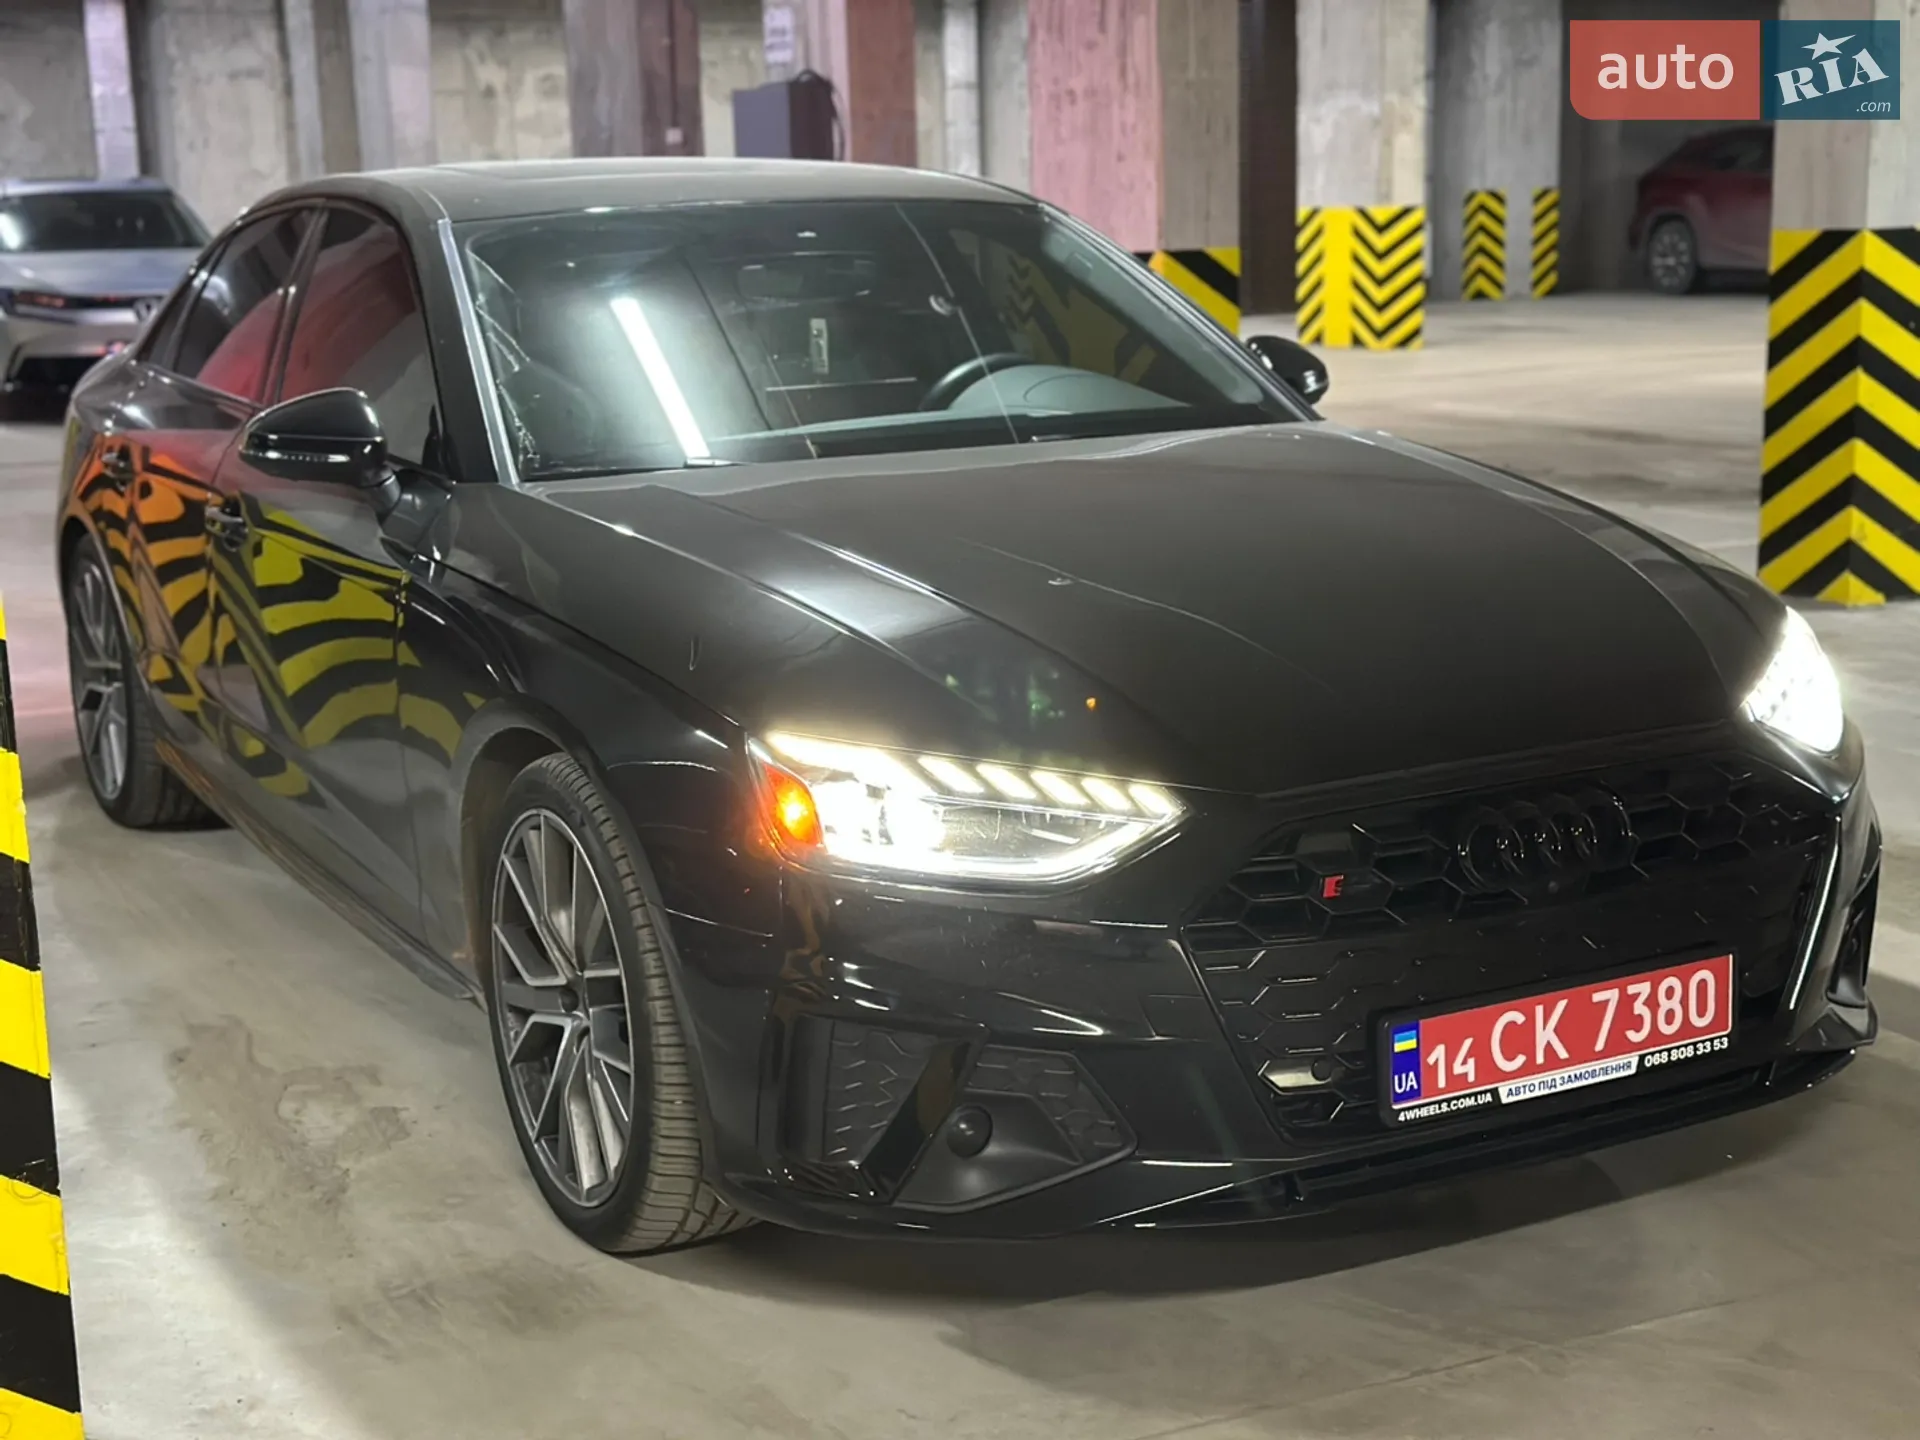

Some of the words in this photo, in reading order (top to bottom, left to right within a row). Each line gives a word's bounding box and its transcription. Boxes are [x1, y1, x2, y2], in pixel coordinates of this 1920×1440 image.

[1426, 1037, 1475, 1089] 14
[1490, 999, 1569, 1073] CK
[1591, 969, 1716, 1053] 7380
[1644, 1051, 1668, 1068] 068
[1670, 1045, 1694, 1061] 808
[1696, 1041, 1711, 1055] 33
[1713, 1037, 1728, 1051] 53
[1394, 1071, 1418, 1094] UA
[1506, 1083, 1536, 1098] АВТО
[1538, 1080, 1557, 1092] ПІД
[1559, 1061, 1632, 1087] ЗАМОВЛЕННЯ
[1398, 1092, 1493, 1122] 4WHEELS.COM.UA
